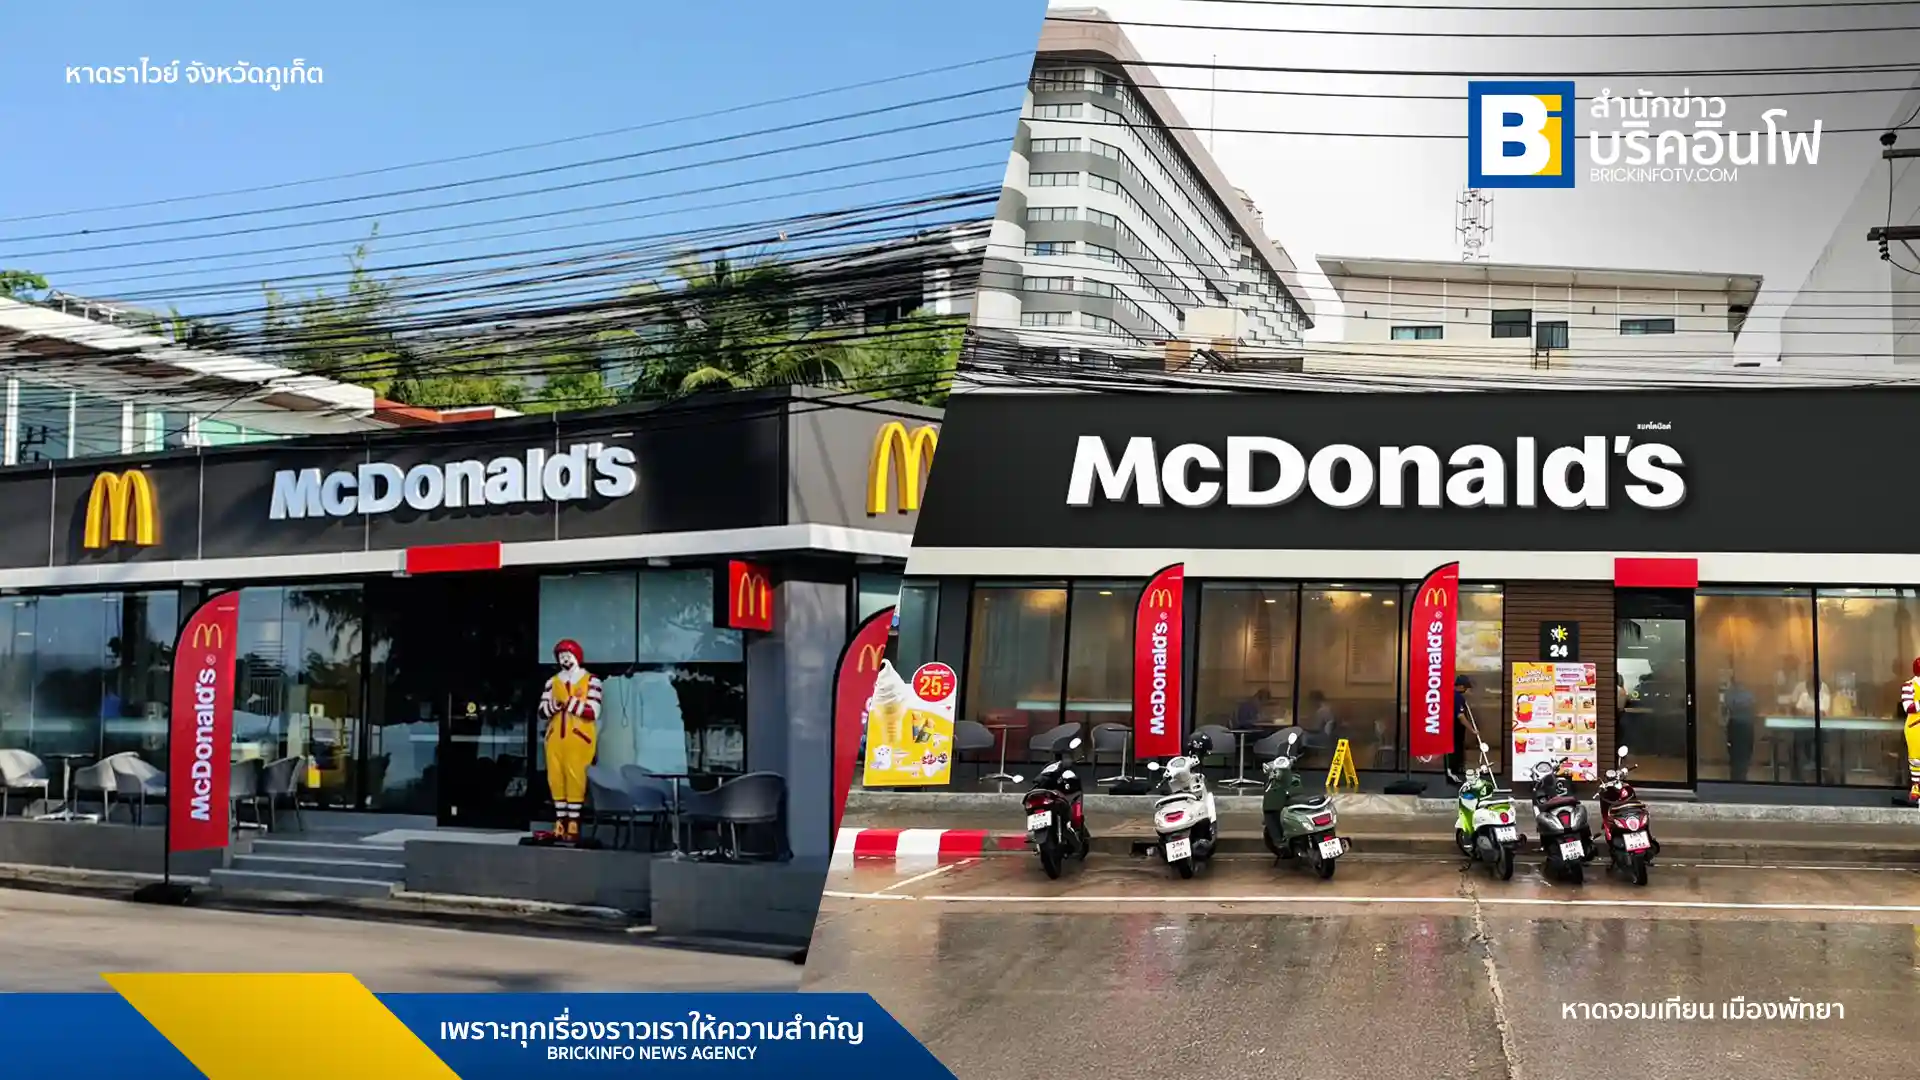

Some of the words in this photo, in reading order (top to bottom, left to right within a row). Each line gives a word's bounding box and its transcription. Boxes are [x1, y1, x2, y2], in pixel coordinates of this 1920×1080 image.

[269, 442, 637, 520] McDonald's
[1067, 436, 1686, 509] McDonald's
[1549, 645, 1569, 658] 24
